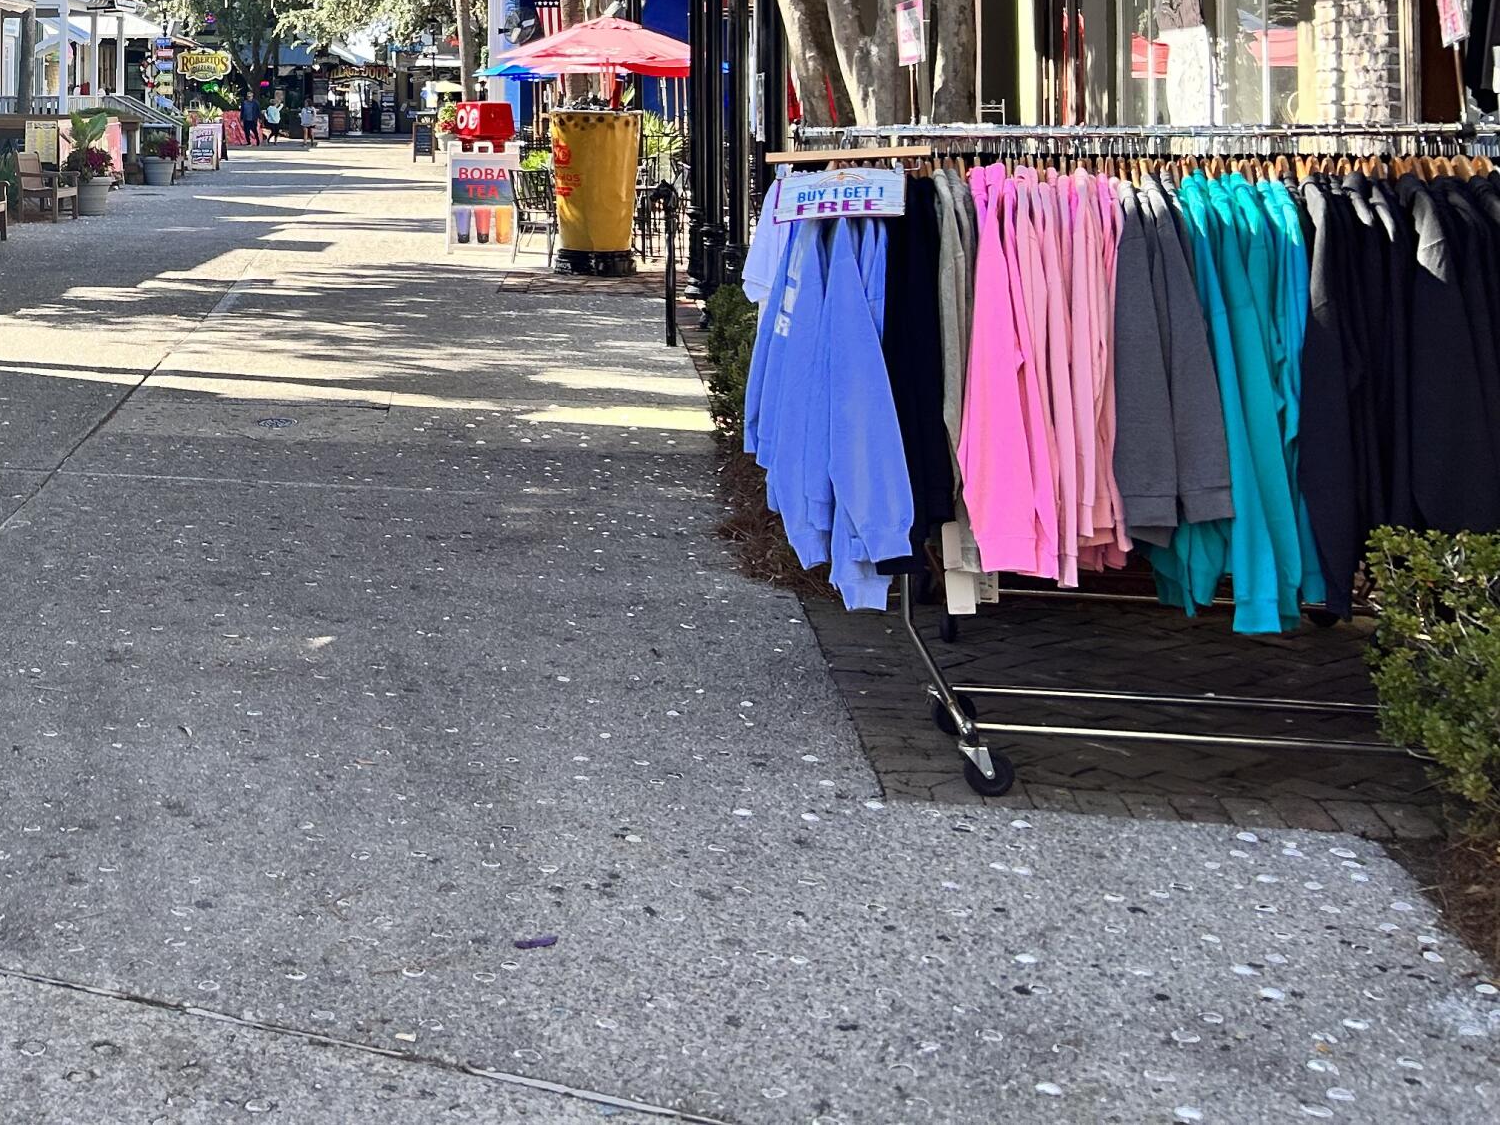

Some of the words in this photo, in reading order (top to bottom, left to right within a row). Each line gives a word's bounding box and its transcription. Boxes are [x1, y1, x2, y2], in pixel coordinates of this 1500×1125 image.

[458, 167, 507, 180] BOBA
[466, 184, 500, 199] TEA
[797, 188, 826, 203] BUY
[832, 187, 838, 199] 1
[843, 186, 871, 198] GET
[877, 186, 884, 197] 1
[796, 199, 884, 215] FREE
